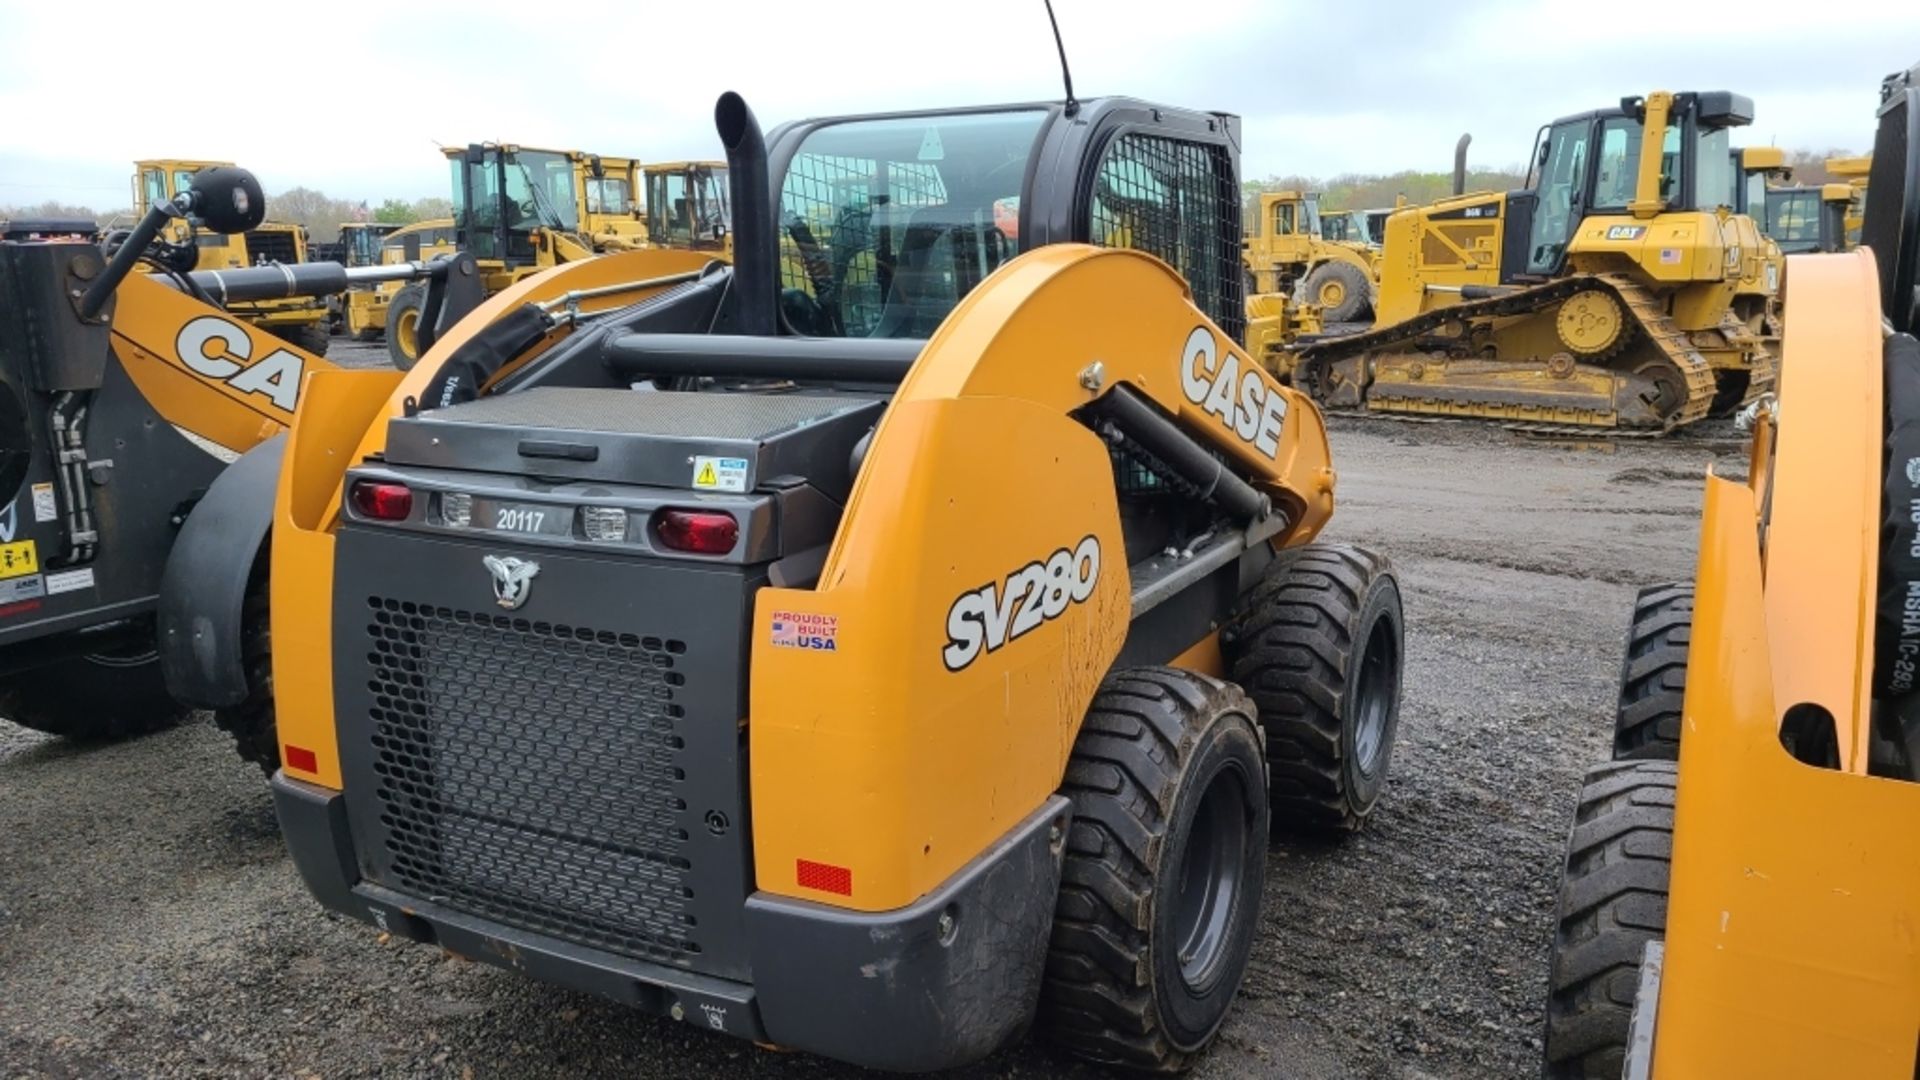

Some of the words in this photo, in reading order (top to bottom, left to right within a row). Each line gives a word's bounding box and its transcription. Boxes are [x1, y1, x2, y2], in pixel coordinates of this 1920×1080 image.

[1609, 226, 1639, 239] CAT
[176, 315, 305, 414] CA
[1181, 325, 1288, 461] CASE
[497, 508, 544, 532] 20117
[942, 534, 1101, 673] SV280
[773, 612, 837, 625] PROUDLY
[798, 625, 837, 636] BUILT
[798, 635, 836, 650] USA
